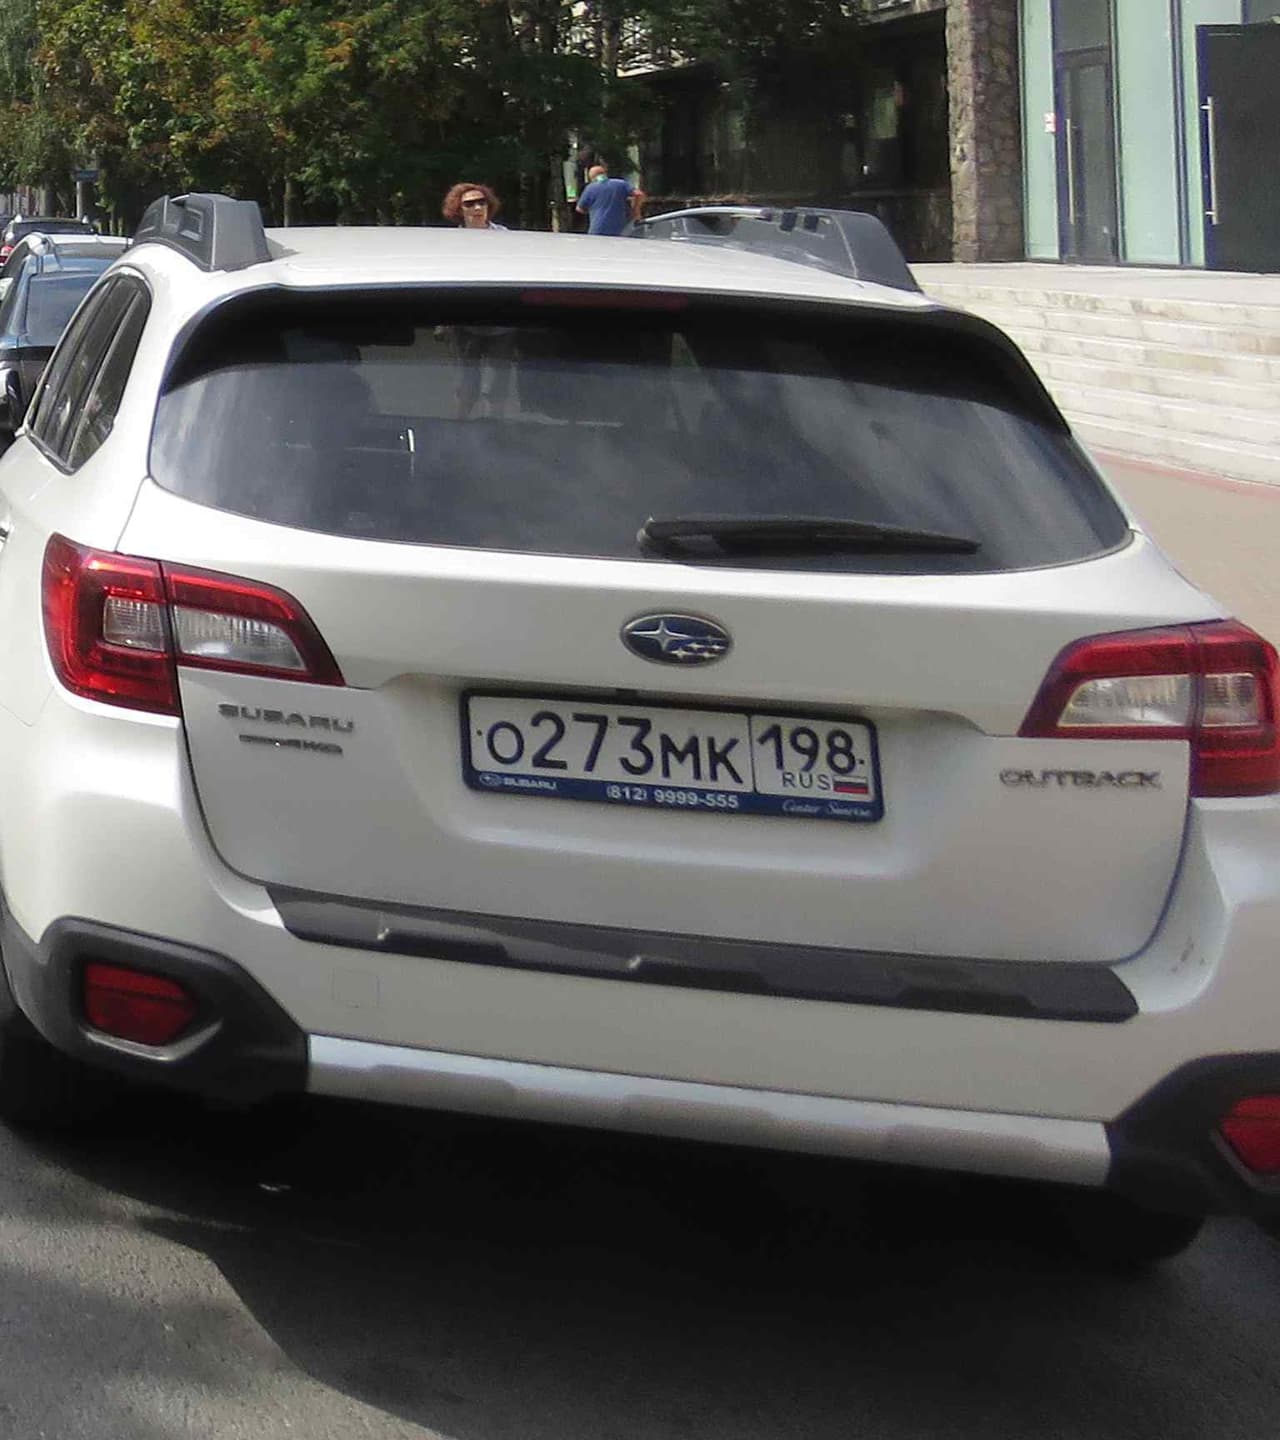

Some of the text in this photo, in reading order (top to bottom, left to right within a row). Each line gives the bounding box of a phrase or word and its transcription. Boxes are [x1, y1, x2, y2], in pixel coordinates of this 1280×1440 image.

[218, 703, 354, 733] SUBARU
[756, 723, 857, 775] 198
[503, 777, 557, 790] SUBARU
[782, 771, 831, 791] RUS
[998, 769, 1163, 788] OUTBACK
[606, 784, 739, 809] (812) 9999-555
